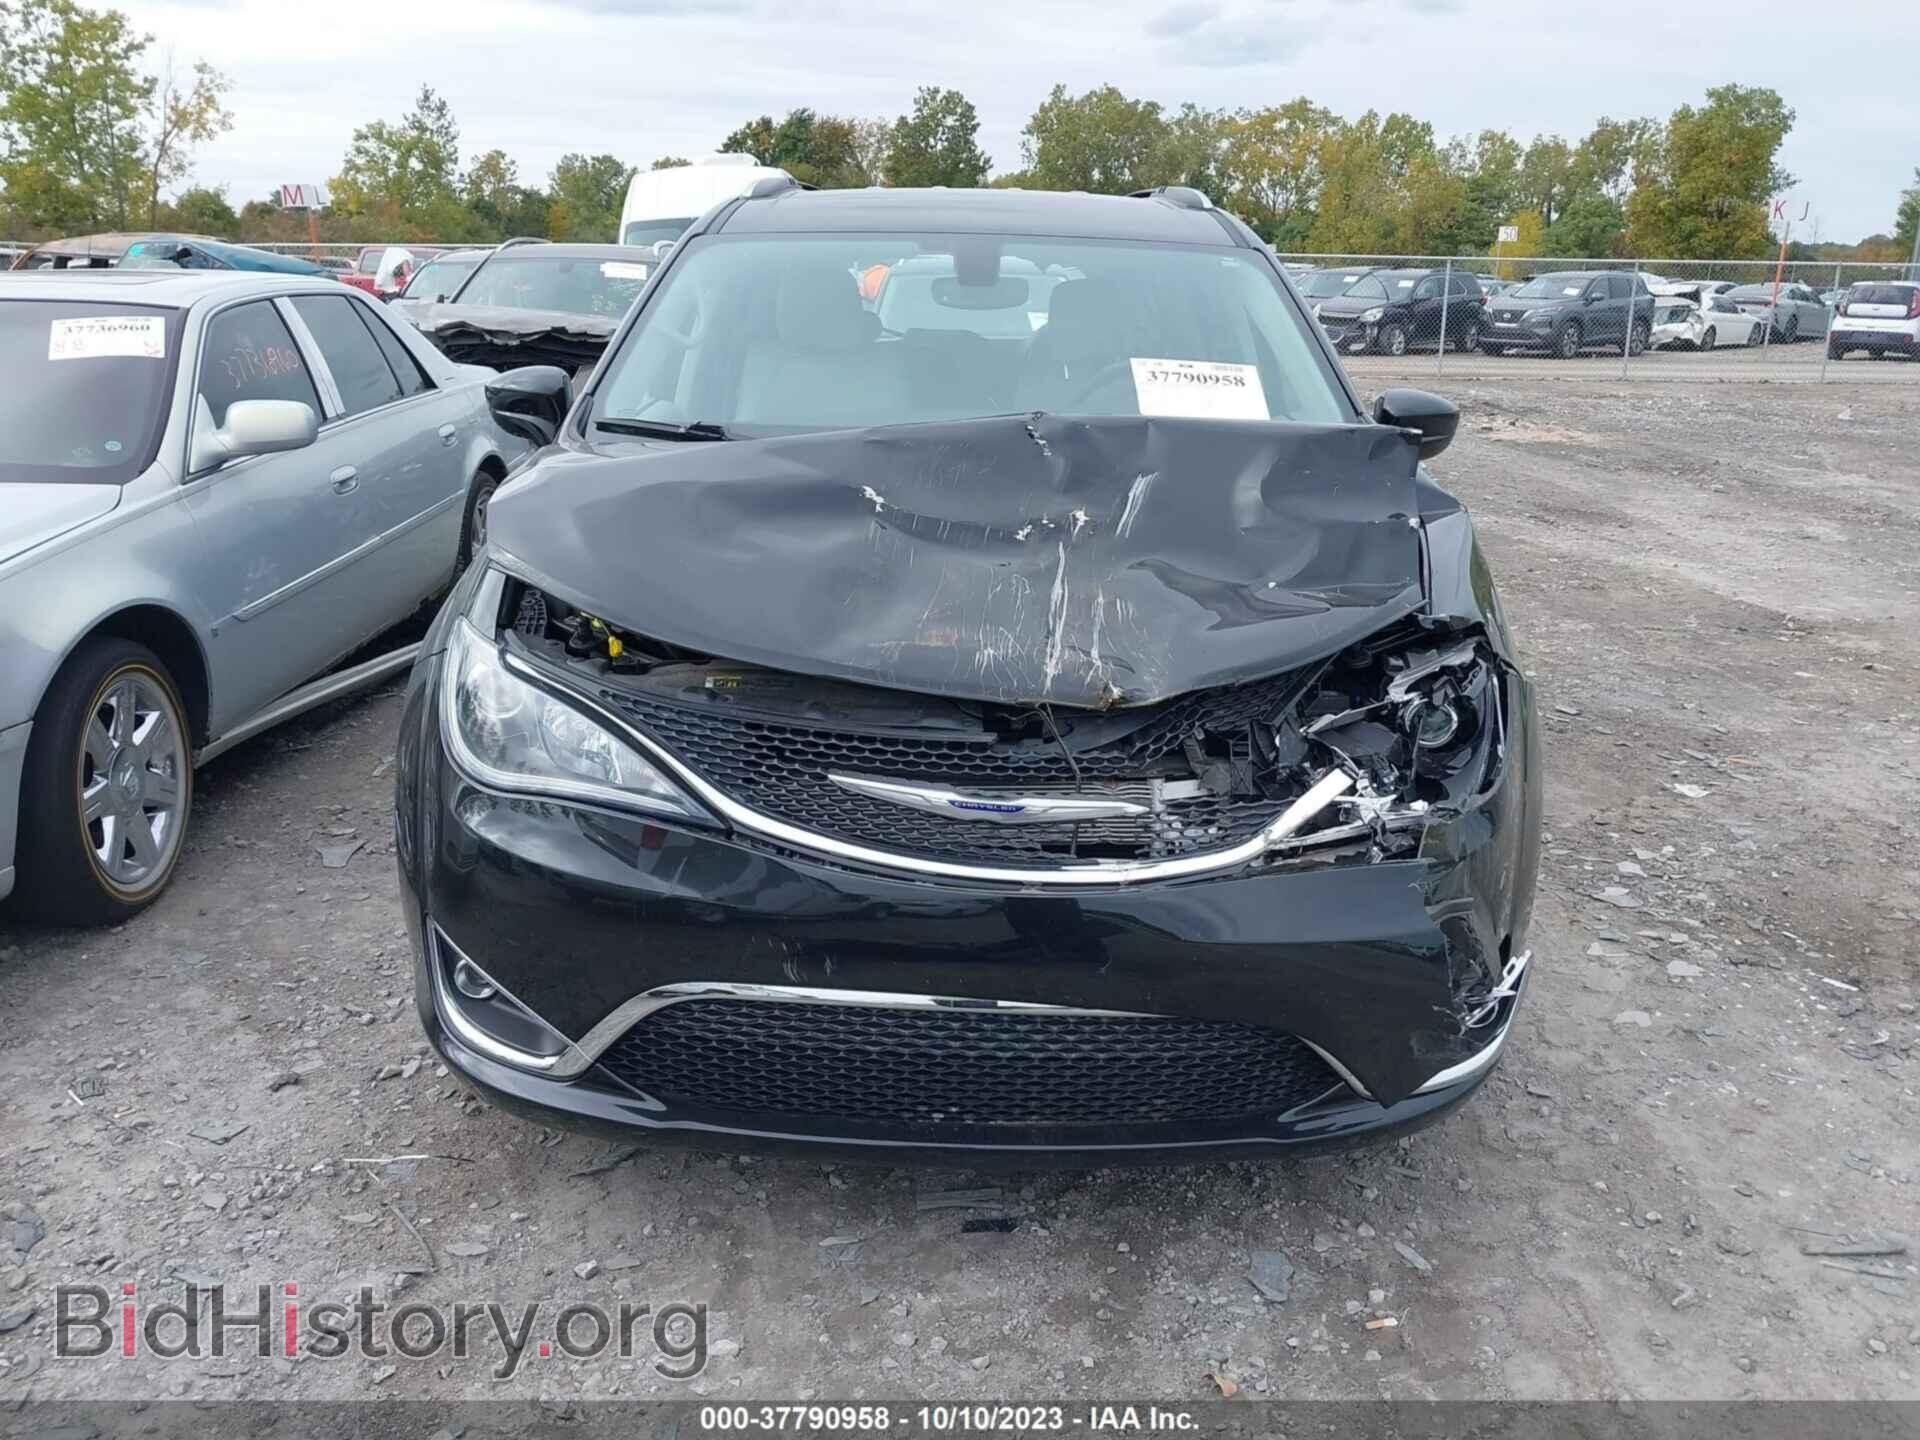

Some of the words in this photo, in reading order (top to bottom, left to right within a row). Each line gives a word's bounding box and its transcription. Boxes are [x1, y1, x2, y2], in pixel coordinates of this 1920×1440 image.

[282, 184, 305, 206] M
[1773, 200, 1786, 220] K
[1798, 201, 1810, 221] J
[1146, 370, 1247, 388] 37790958
[953, 800, 1018, 811] CHRYSLER
